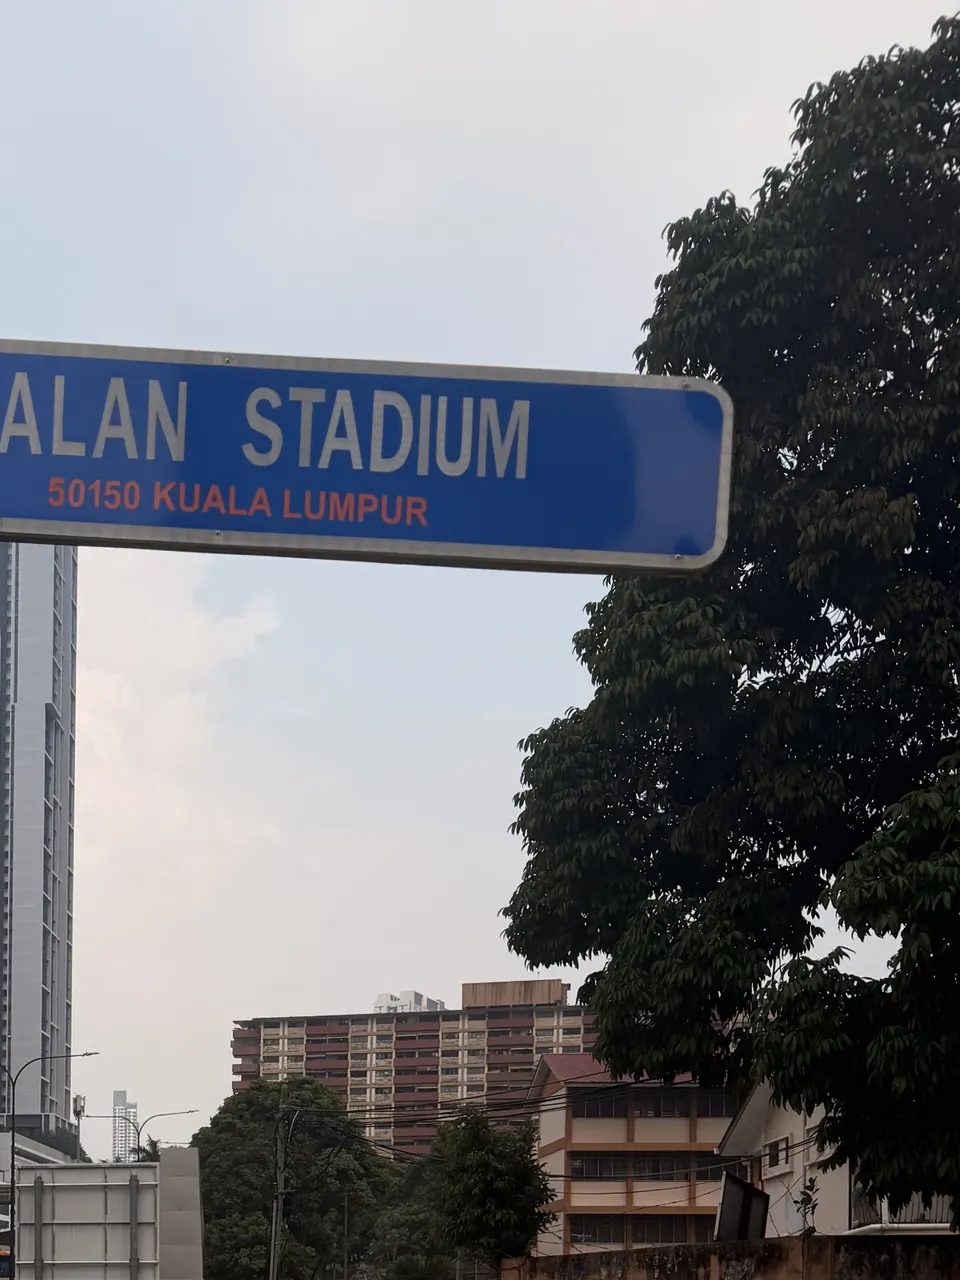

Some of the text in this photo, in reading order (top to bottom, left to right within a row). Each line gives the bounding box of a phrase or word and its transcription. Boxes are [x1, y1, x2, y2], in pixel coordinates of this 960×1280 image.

[241, 386, 530, 479] STADIUM
[48, 477, 429, 527] 50150 KUALA LUMPUR
